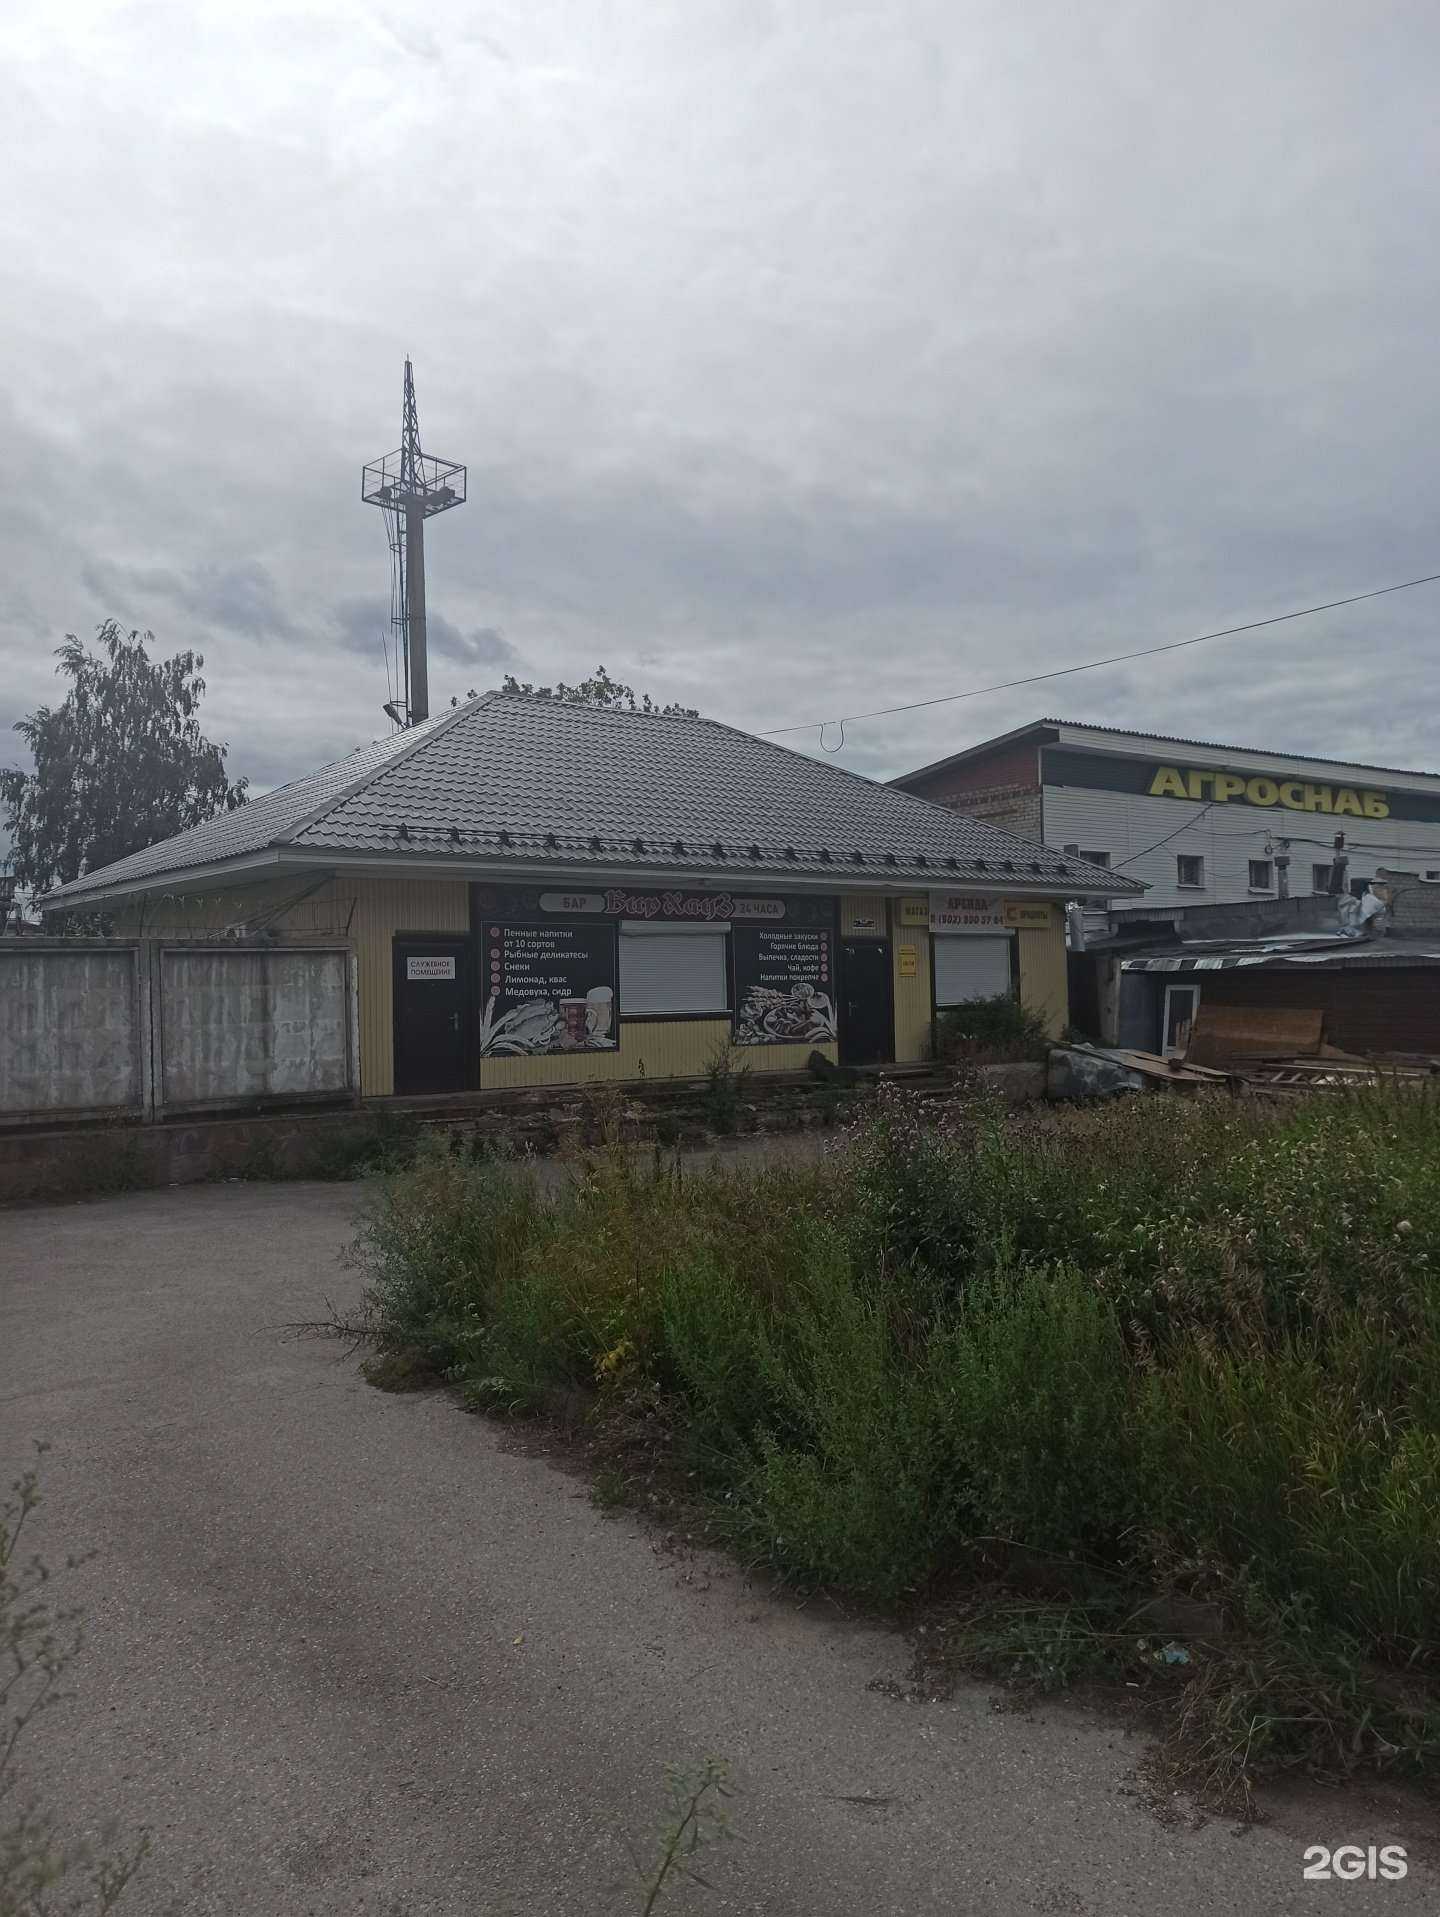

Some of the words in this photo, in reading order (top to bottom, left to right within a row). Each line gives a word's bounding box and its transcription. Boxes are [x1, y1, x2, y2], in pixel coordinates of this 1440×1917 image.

[1149, 766, 1390, 819] АГРОСНАБ
[563, 898, 587, 910] БАР
[739, 902, 751, 914] 24
[753, 903, 779, 915] ЧАСА
[504, 928, 538, 938] Пенные
[539, 930, 573, 939] напитки
[516, 939, 526, 948] 10
[527, 942, 556, 950] сортов
[770, 942, 797, 951] Горячие
[504, 949, 539, 959] Рыбные
[540, 951, 589, 961] деликатесы
[410, 960, 450, 968] СЛУЖЕБНОЕ
[504, 962, 531, 971] Снеки
[505, 975, 548, 985] Лимонад,
[760, 973, 788, 982] Напитки
[505, 987, 550, 998] Медовуха,
[551, 988, 573, 997] сидр
